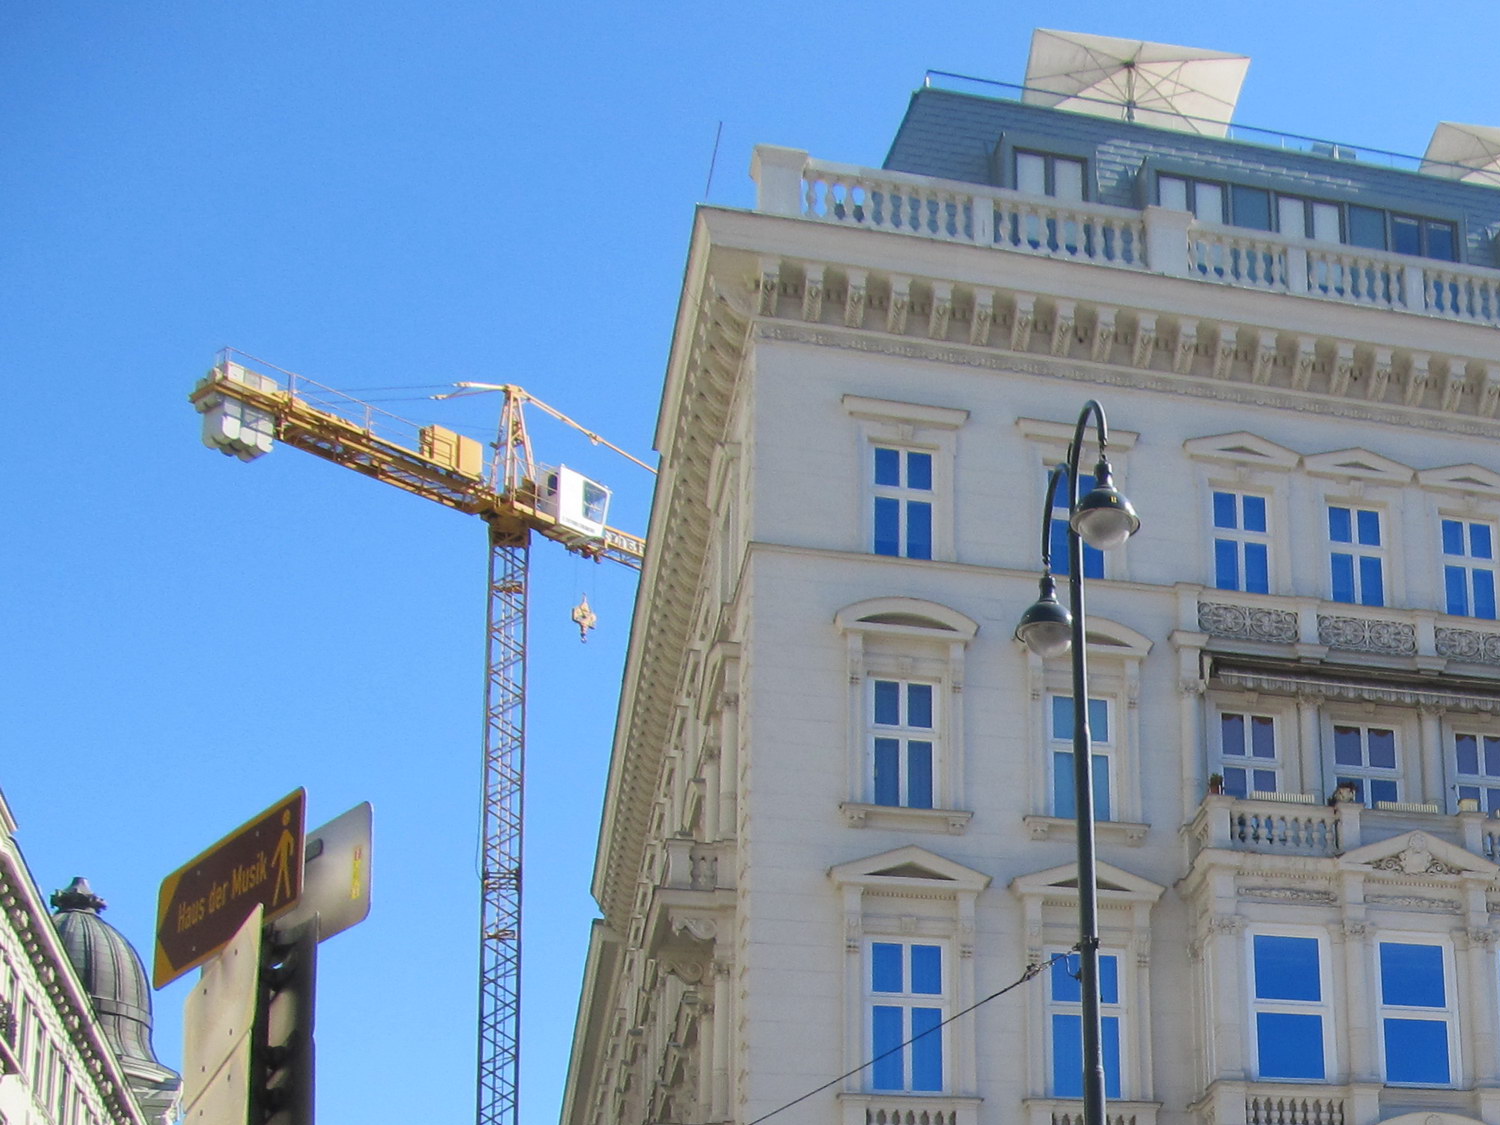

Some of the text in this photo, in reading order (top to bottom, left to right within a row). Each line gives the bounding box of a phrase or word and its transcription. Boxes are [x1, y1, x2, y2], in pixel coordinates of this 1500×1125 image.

[177, 851, 268, 933] Haus der Musik
